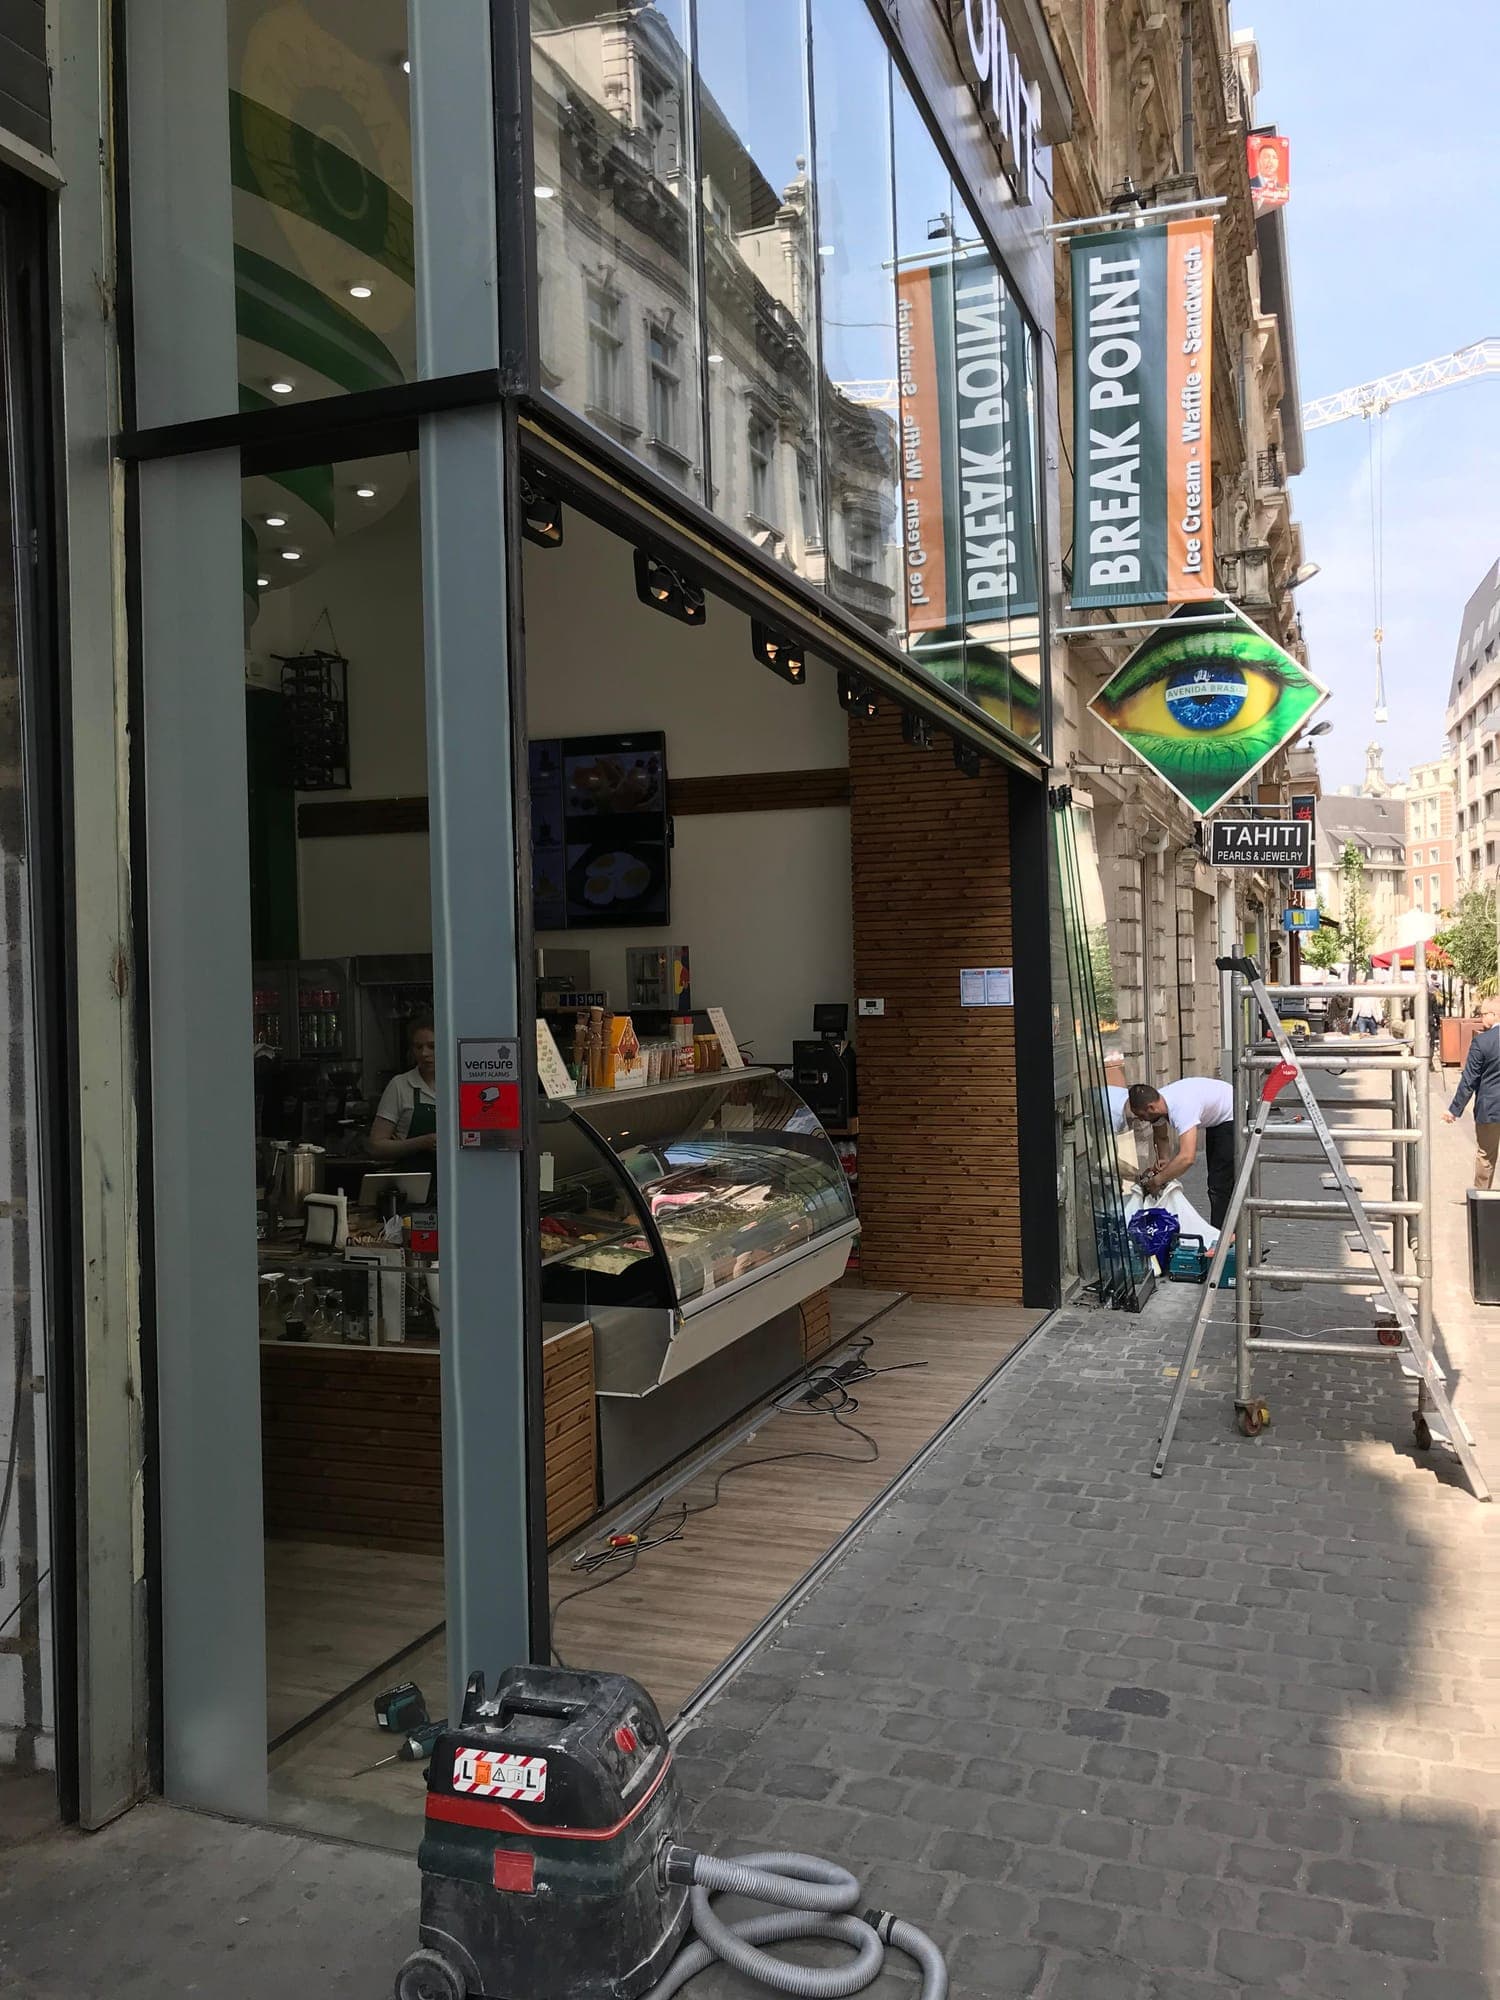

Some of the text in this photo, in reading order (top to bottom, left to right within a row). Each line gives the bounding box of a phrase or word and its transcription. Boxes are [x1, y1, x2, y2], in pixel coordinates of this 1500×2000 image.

[1182, 246, 1203, 355] Sandwich
[1088, 257, 1142, 585] BREAK POINT
[1181, 371, 1202, 443] Waffle
[1181, 460, 1202, 533] Cream
[1181, 537, 1202, 575] Ice
[1167, 683, 1244, 698] AVENIDA BRASI
[1221, 826, 1301, 846] TAHITI
[1217, 850, 1303, 862] PEARLS & JEWELRY
[464, 1060, 513, 1070] verisure
[463, 1760, 537, 1788] L L
